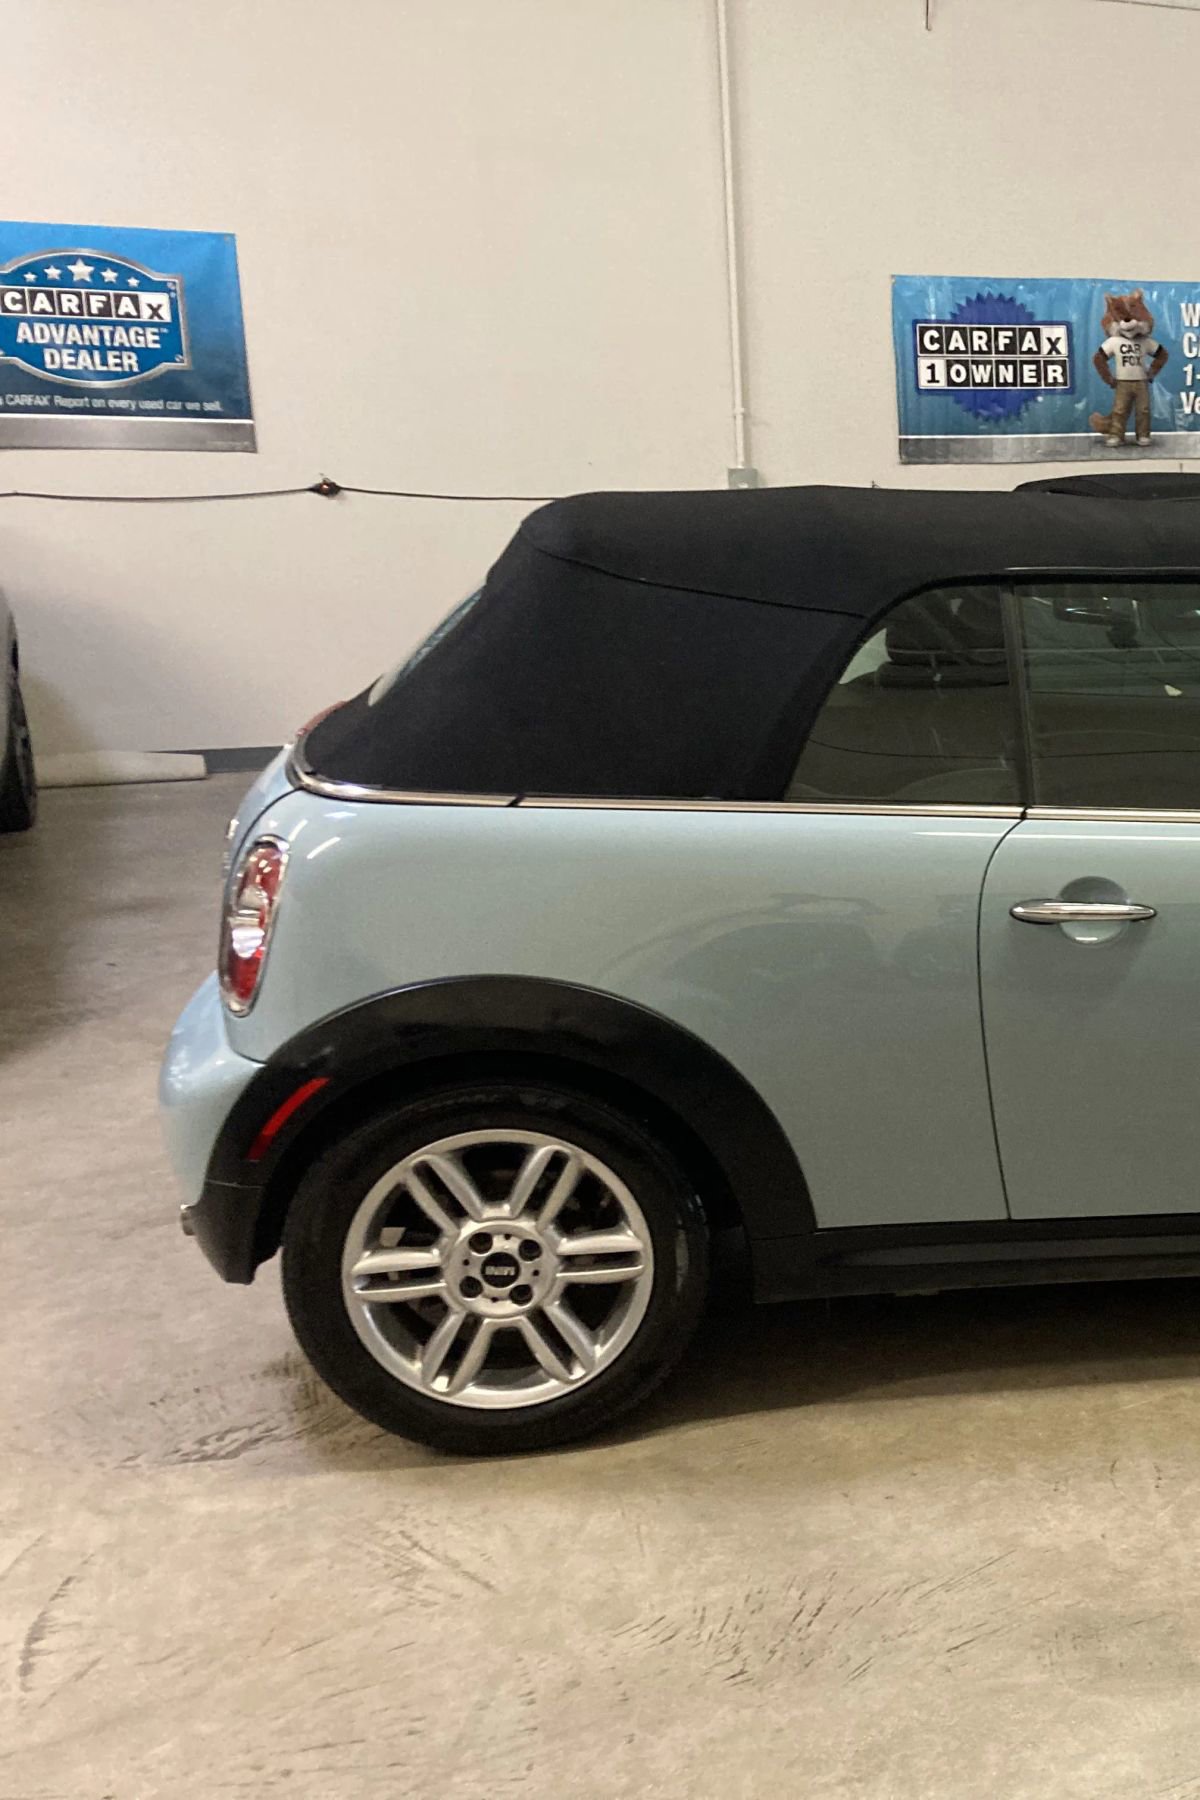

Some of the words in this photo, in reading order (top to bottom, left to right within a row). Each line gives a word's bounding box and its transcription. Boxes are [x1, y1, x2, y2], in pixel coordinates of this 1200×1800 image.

[3, 291, 164, 320] CARFAX
[922, 328, 1064, 354] CARFAX
[1119, 343, 1141, 354] CAR
[43, 348, 140, 372] DEALER
